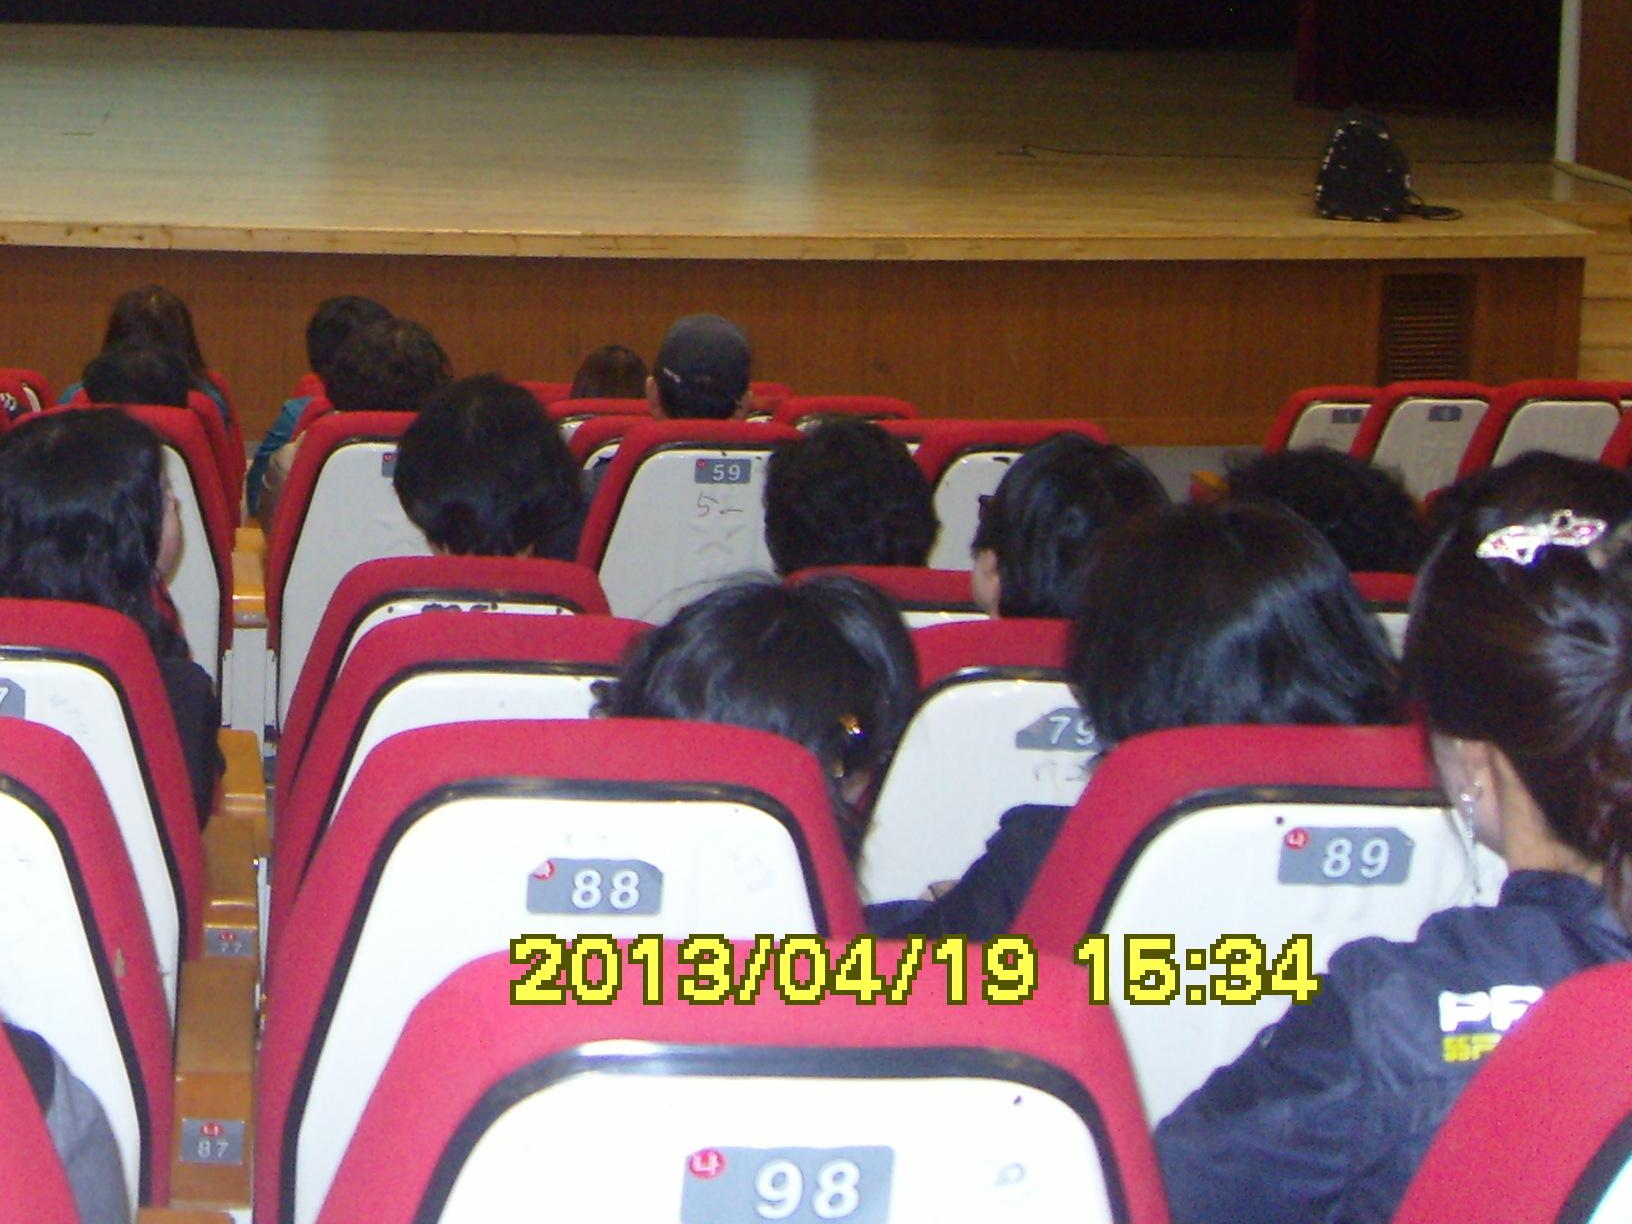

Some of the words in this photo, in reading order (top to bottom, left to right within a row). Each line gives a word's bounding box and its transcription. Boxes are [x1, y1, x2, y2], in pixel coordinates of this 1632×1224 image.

[712, 463, 742, 481] 59
[1049, 715, 1096, 746] 79
[1322, 836, 1390, 879] 89
[571, 868, 640, 910] 88
[197, 1139, 229, 1158] 87
[753, 1157, 862, 1220] 98
